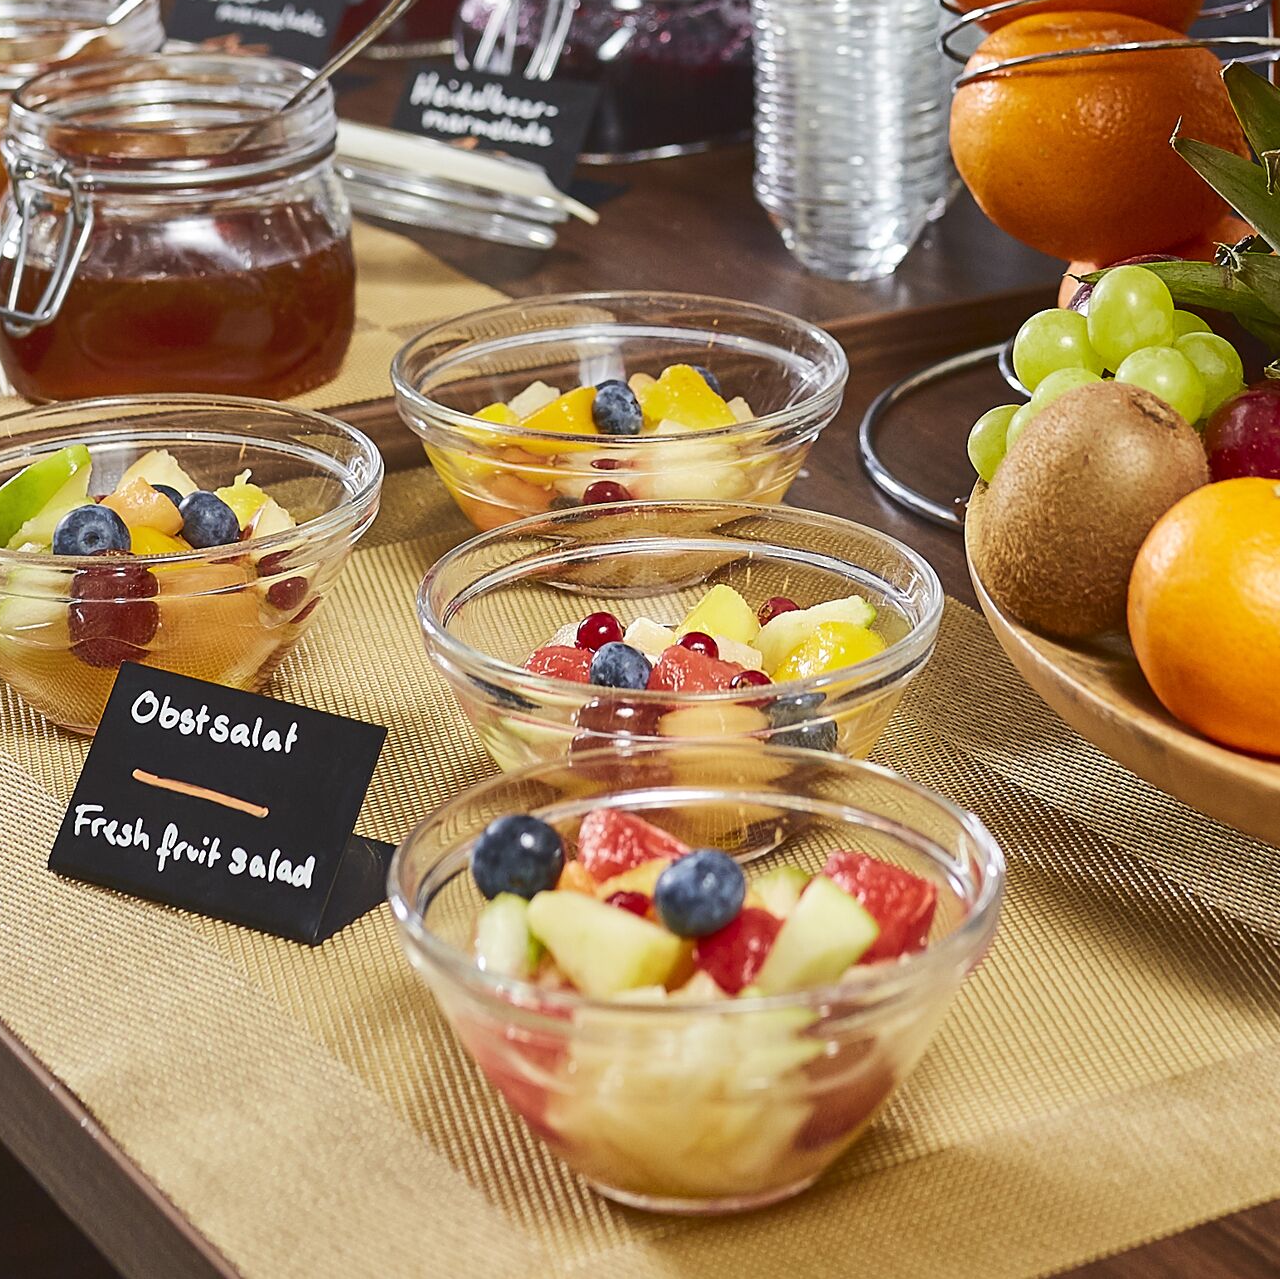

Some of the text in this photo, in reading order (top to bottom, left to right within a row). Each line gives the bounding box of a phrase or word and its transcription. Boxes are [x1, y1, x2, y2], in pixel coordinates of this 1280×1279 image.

[130, 689, 298, 754] Obstsalat
[73, 803, 316, 889] Fresh fruit salad
